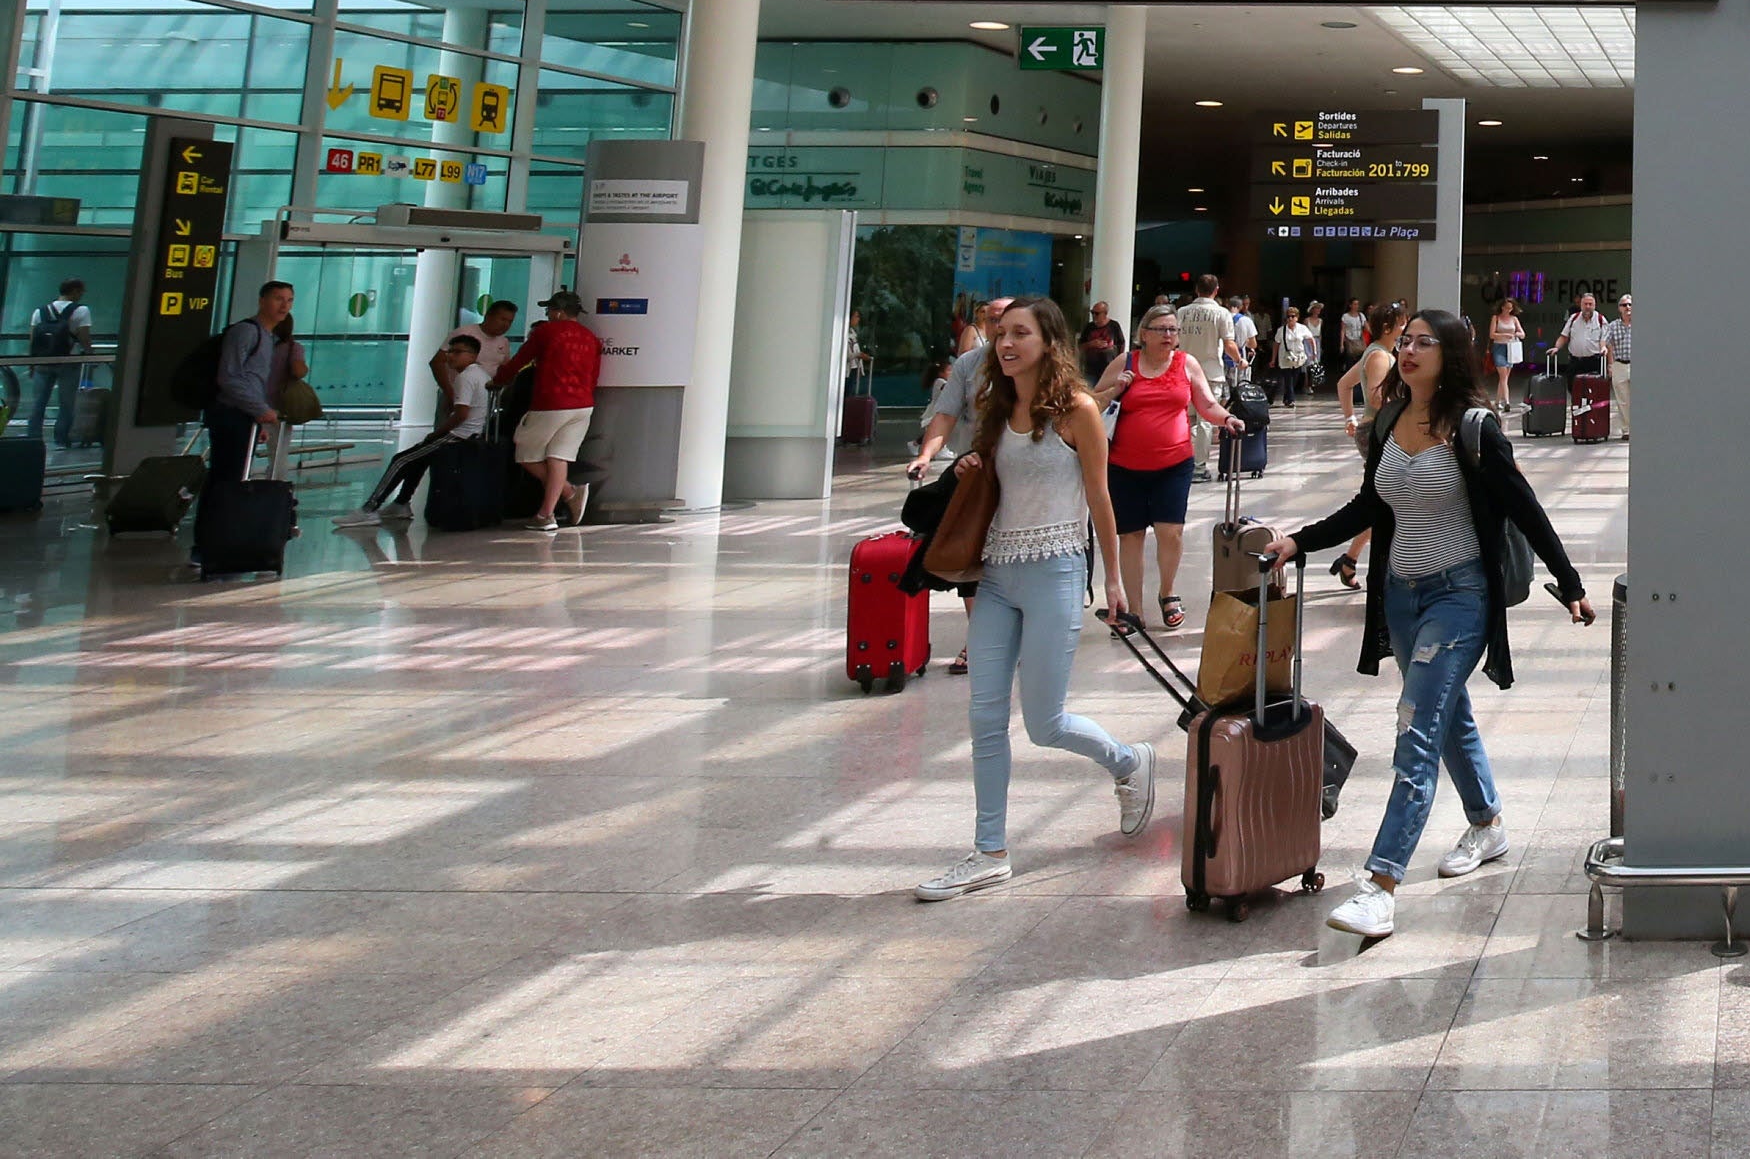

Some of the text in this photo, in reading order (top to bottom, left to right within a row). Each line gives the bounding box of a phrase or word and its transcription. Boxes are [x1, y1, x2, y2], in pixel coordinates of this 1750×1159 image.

[1318, 112, 1357, 121] Sortides
[1318, 122, 1357, 130] Departures
[1318, 131, 1351, 139] Salidas
[1317, 149, 1361, 158] Facturació
[332, 153, 349, 169] 46
[358, 155, 380, 172] PR1
[415, 161, 435, 177] L77
[441, 164, 461, 179] L99
[467, 166, 485, 178] N17
[1316, 168, 1365, 177] Facturación
[1368, 163, 1394, 177] 201
[1403, 163, 1430, 177] 799
[1315, 187, 1358, 196] Arribades
[1315, 197, 1345, 205] Arrivals
[1314, 206, 1354, 216] Llegadas
[1373, 226, 1419, 239] La Plaça
[165, 268, 184, 279] Bus
[1558, 279, 1617, 304] FIORE
[166, 296, 209, 311] P VIP
[600, 347, 639, 355] MARKET
